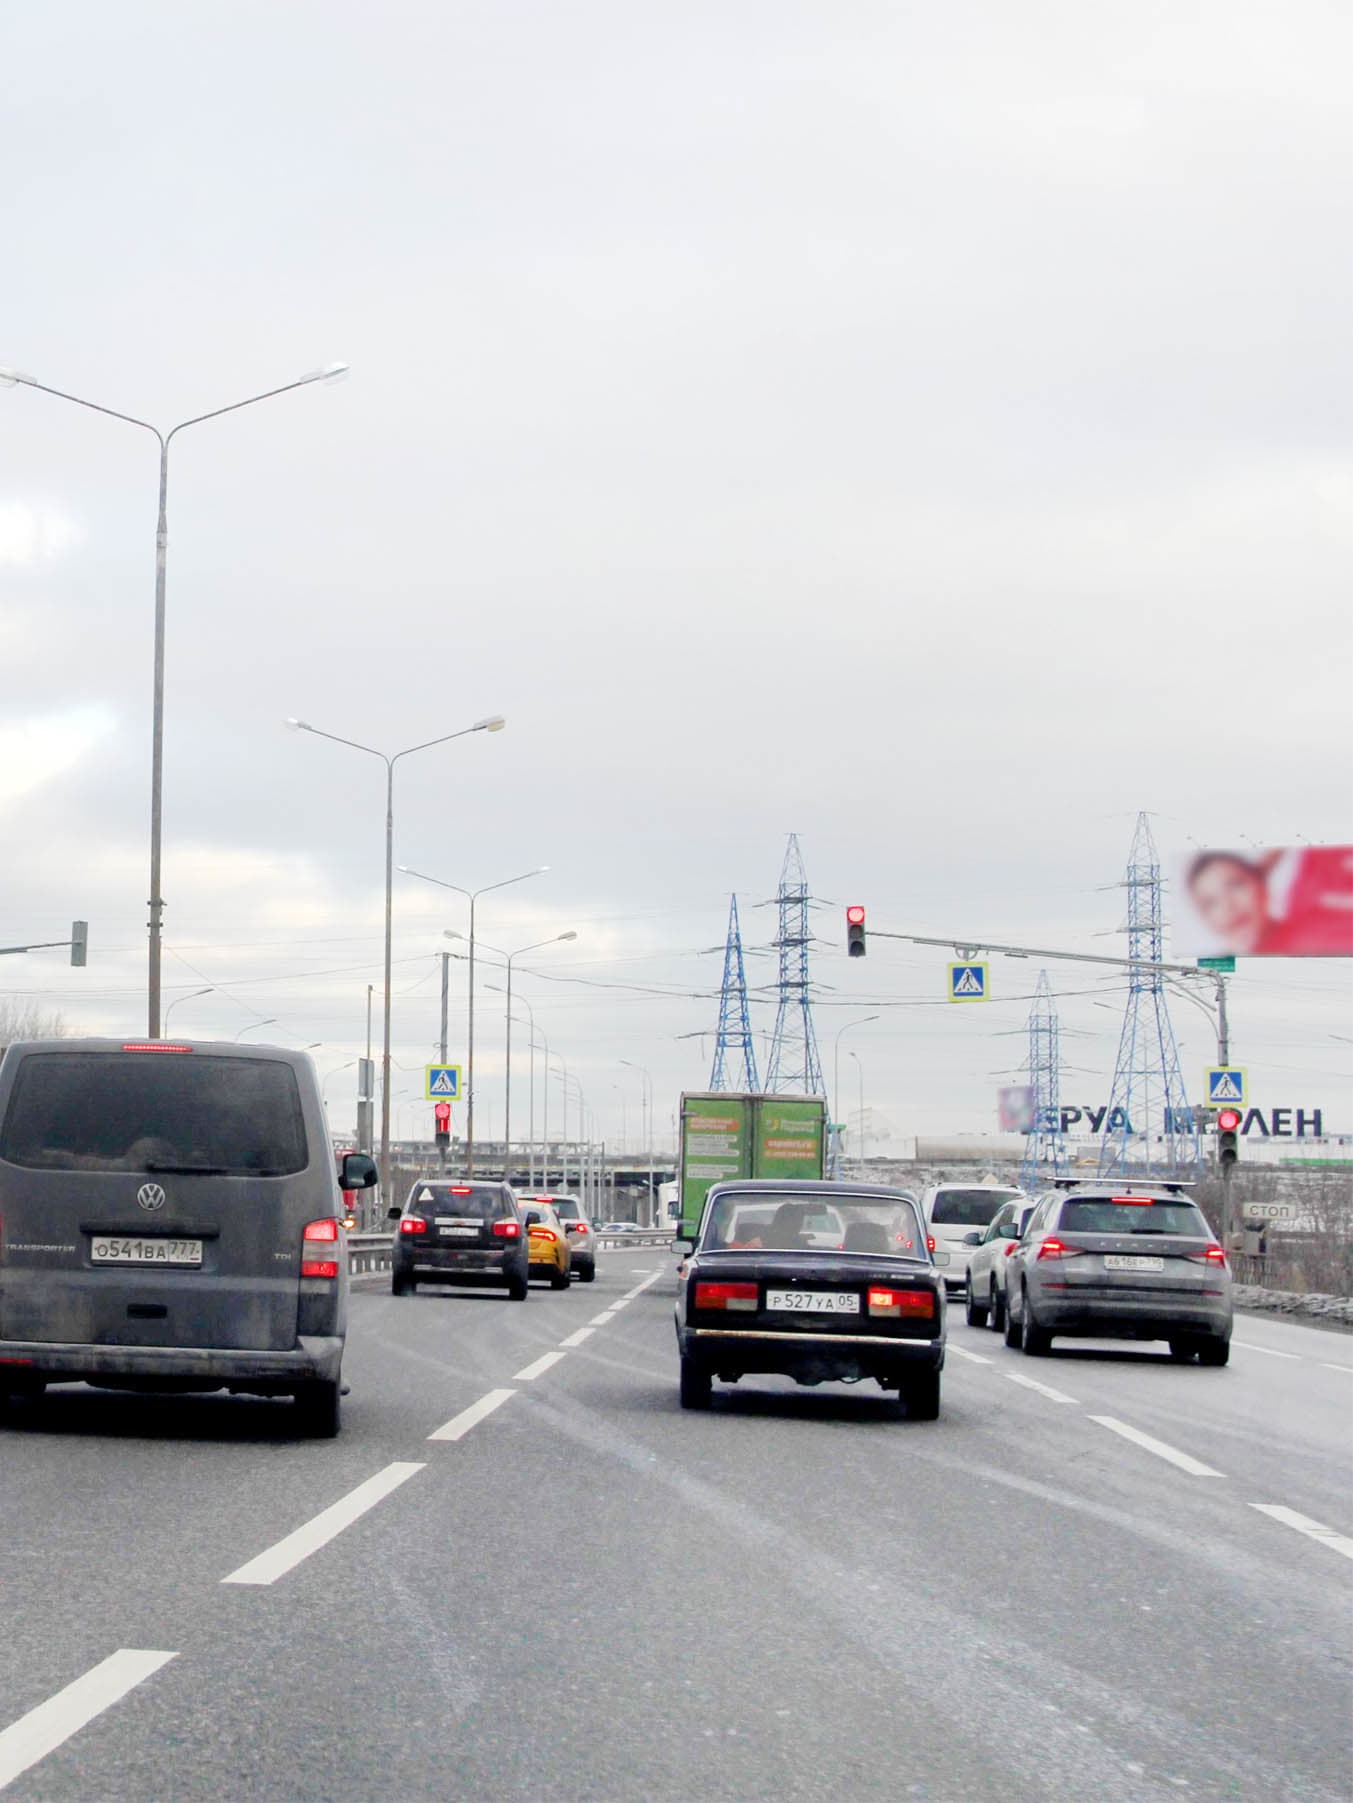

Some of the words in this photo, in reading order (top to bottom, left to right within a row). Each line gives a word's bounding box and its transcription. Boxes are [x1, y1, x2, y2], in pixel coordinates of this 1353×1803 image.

[1021, 1105, 1134, 1135] ЕРУА
[1164, 1106, 1322, 1137] МЛЕН
[1250, 1205, 1289, 1216] СТОП
